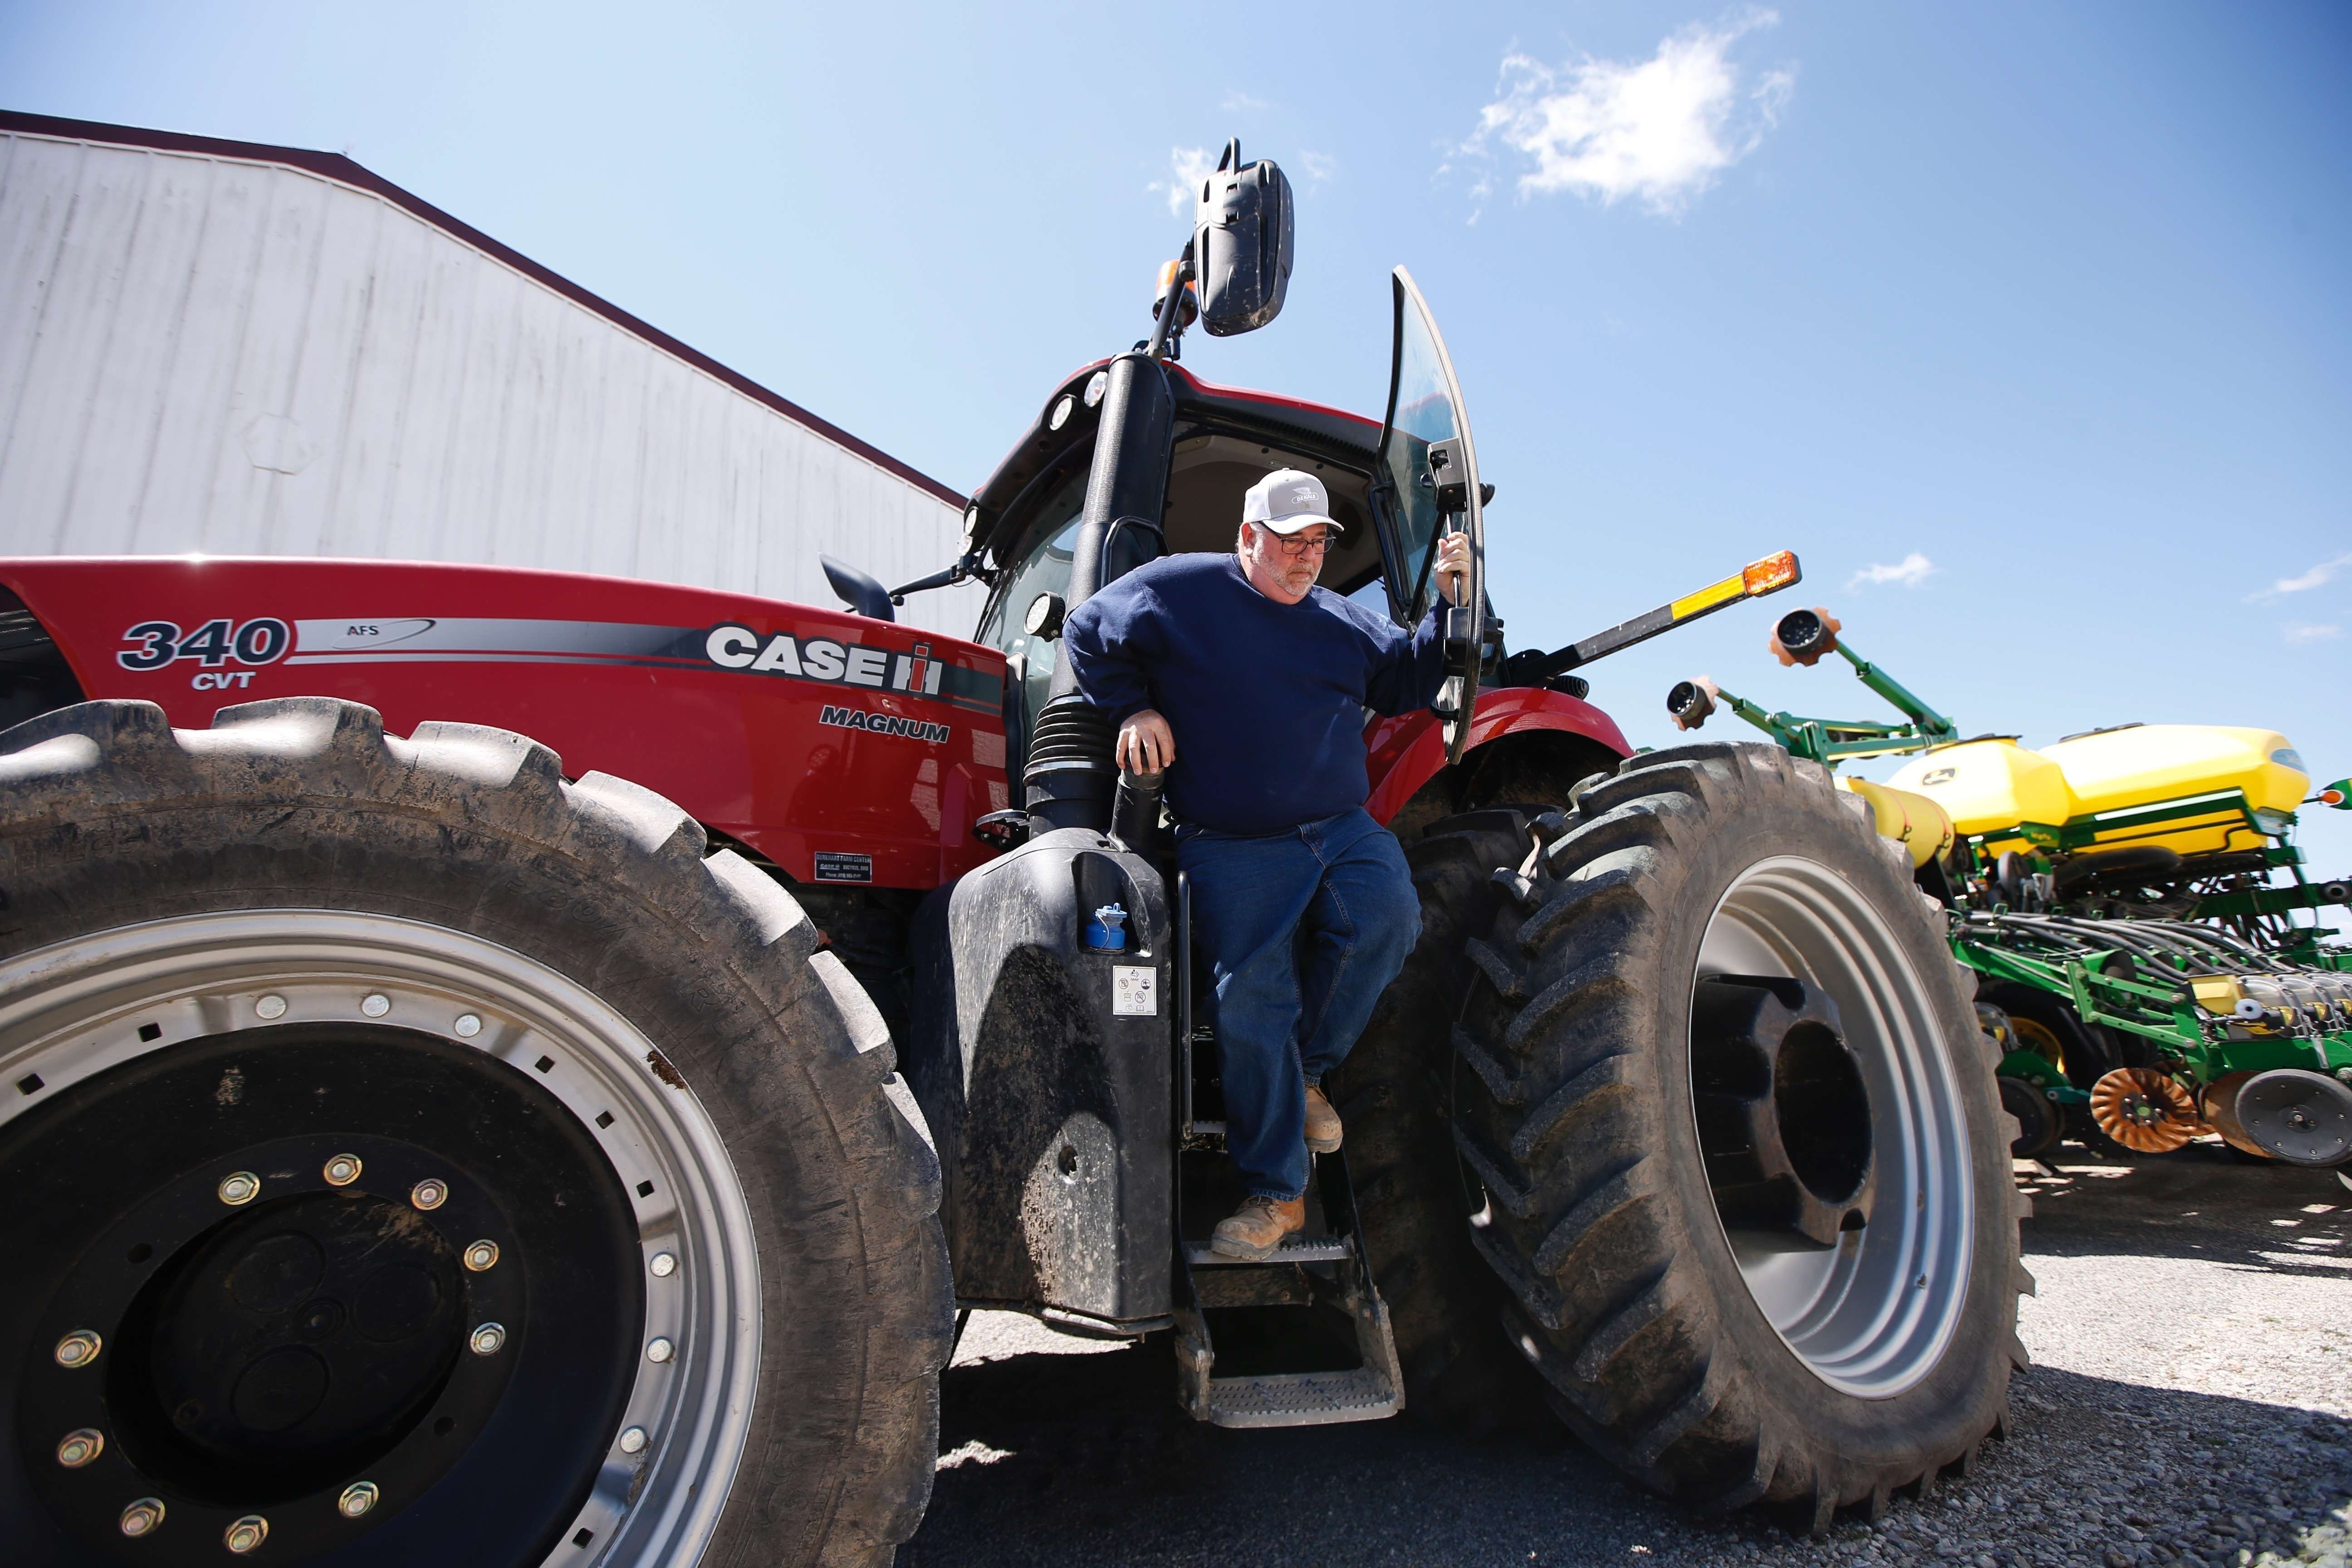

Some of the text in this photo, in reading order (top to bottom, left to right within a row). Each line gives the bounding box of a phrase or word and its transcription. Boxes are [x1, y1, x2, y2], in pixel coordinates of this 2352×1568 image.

[116, 617, 290, 672] 340
[348, 626, 379, 635] AFS
[706, 626, 887, 686] CASE
[191, 671, 256, 691] CVT
[819, 705, 950, 744] MAGNUM
